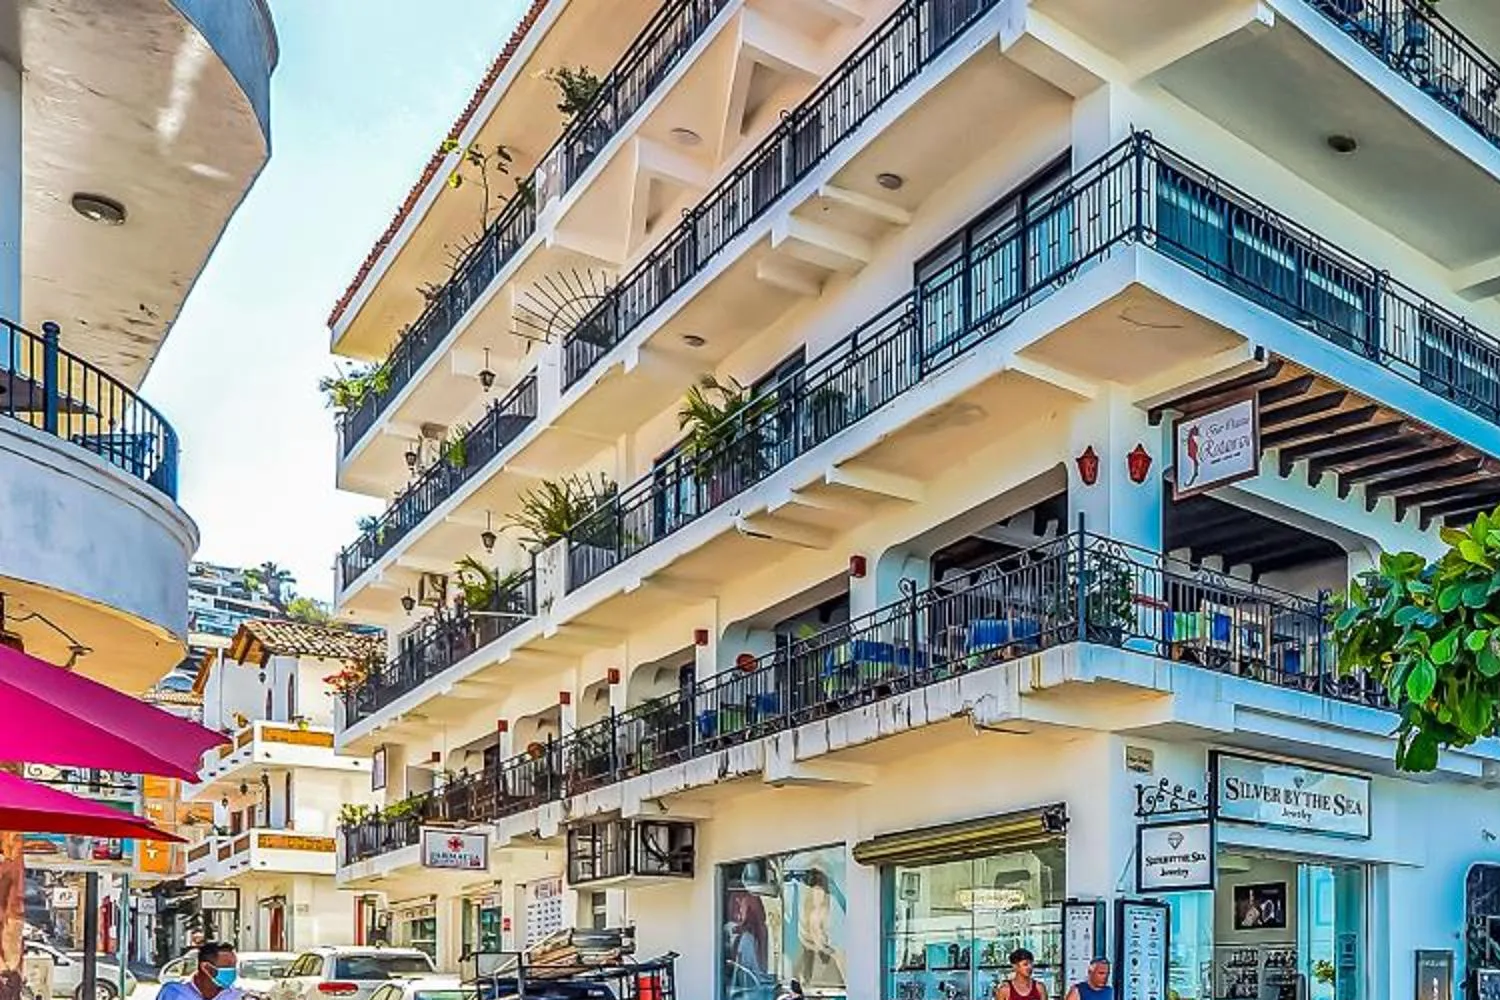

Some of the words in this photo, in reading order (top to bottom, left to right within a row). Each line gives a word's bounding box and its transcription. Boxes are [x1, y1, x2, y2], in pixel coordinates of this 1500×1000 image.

[1225, 777, 1281, 802] SILVER
[1284, 788, 1301, 806] BY
[1303, 791, 1331, 811] THE
[1333, 793, 1363, 817] SEA
[1281, 807, 1313, 823] Jewelry
